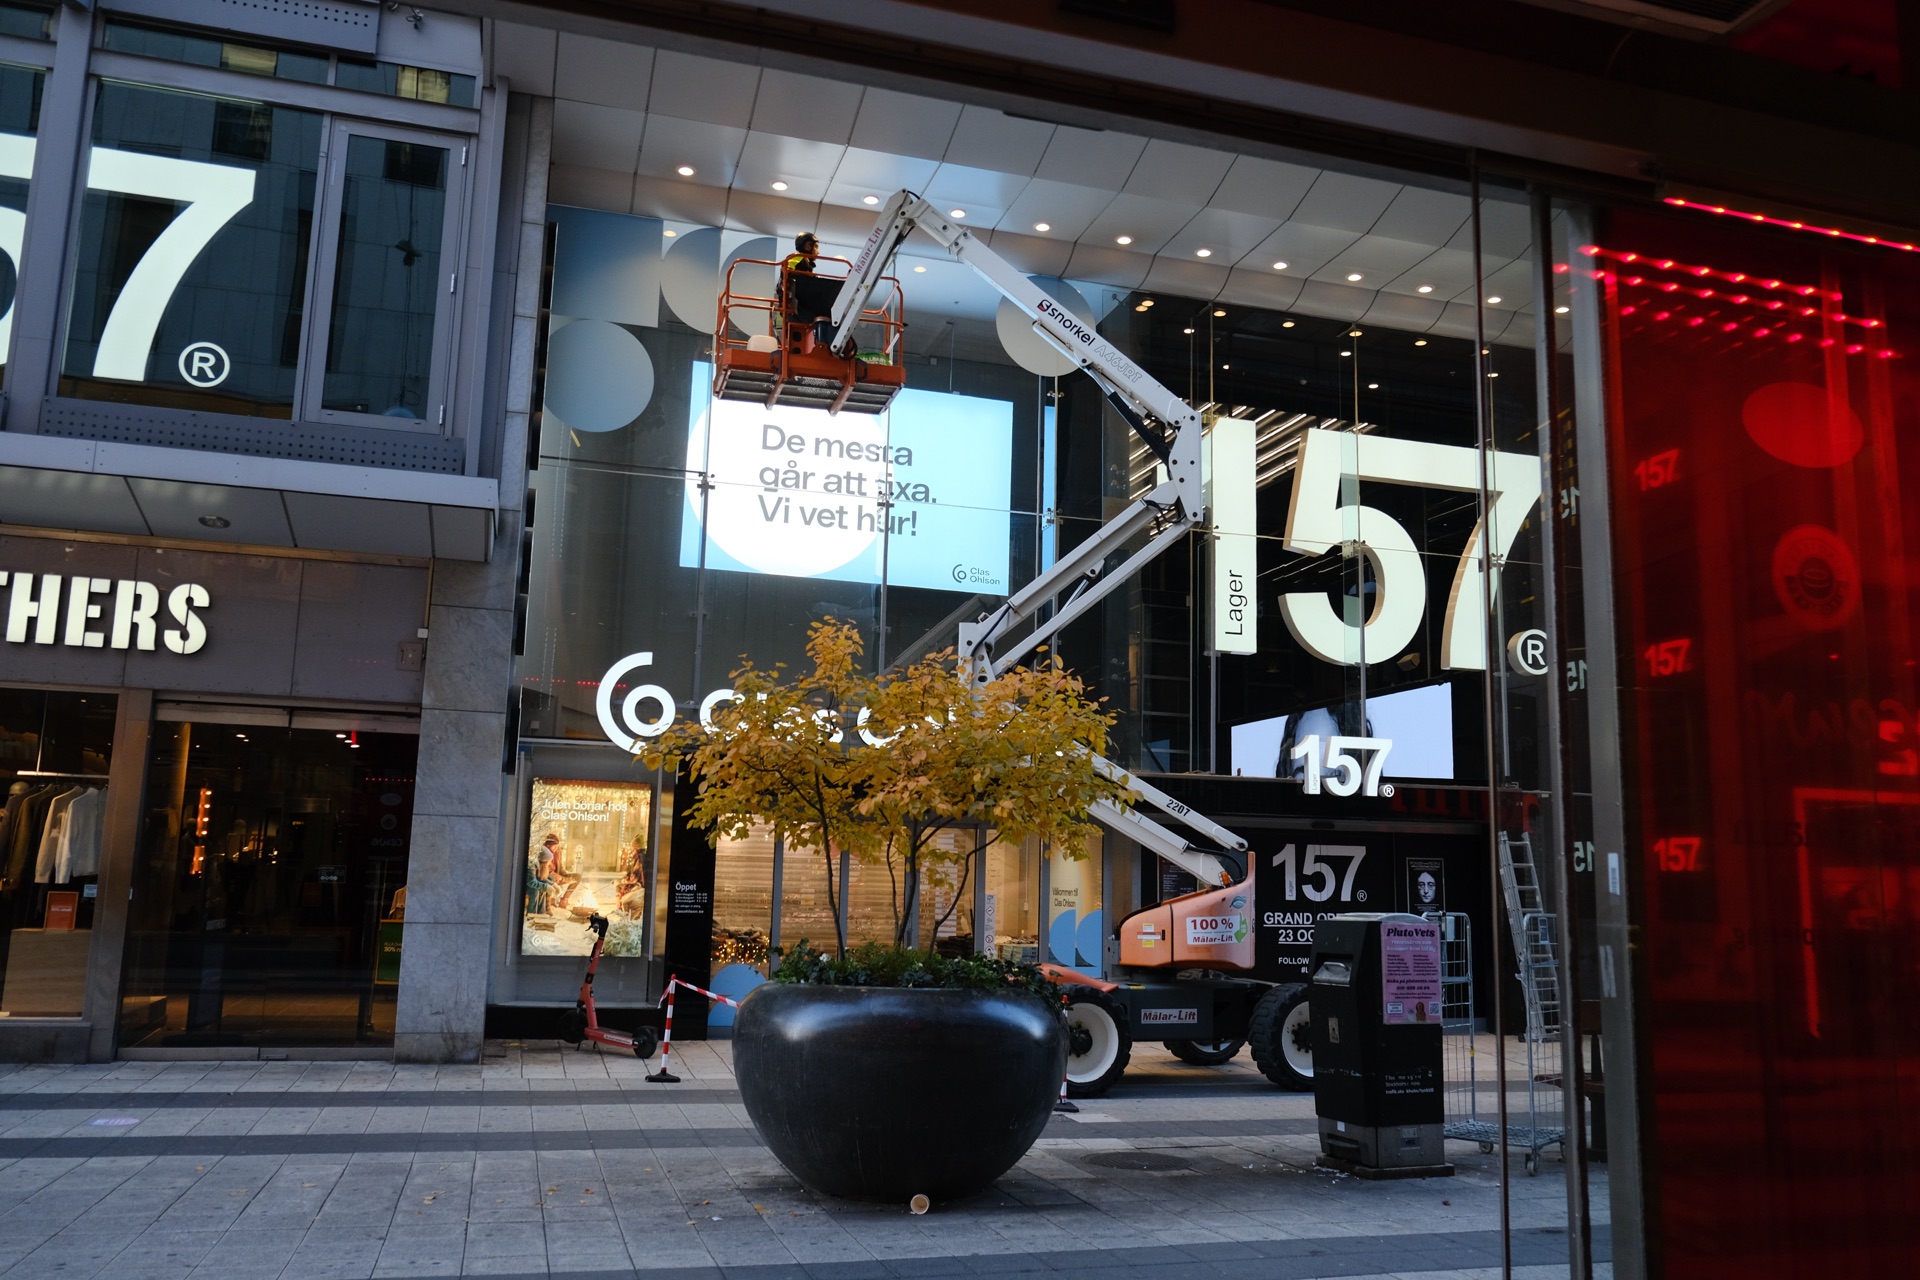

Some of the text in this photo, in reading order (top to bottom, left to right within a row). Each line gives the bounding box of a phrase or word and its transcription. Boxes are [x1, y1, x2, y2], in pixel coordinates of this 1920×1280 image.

[855, 227, 883, 275] Mälar-Lift
[1048, 309, 1096, 346] snorkel
[1094, 345, 1143, 384] A46JRT
[762, 424, 913, 467] De mesta
[759, 456, 816, 495] går
[824, 467, 866, 497] att
[758, 494, 790, 525] Vi
[797, 501, 848, 530] vet
[970, 567, 990, 576] Clas
[969, 575, 1001, 585] Ohlson
[1225, 568, 1246, 637] Lager
[0, 572, 210, 656] HERS
[542, 799, 627, 812] Julen börjar hos
[1166, 799, 1191, 817] 2207
[542, 810, 609, 822] Clas Ohlson!
[675, 881, 697, 892] Öppet
[1052, 887, 1073, 896] Välkommen
[1054, 899, 1076, 908] Clas Ohlson
[1191, 918, 1234, 930] 100 %
[1264, 912, 1313, 925] GRAND
[1192, 934, 1233, 943] Mälar-Lift
[1278, 929, 1294, 942] 23
[1278, 957, 1310, 965] FOLLOW
[1142, 1010, 1196, 1021] Mälar-Lift
